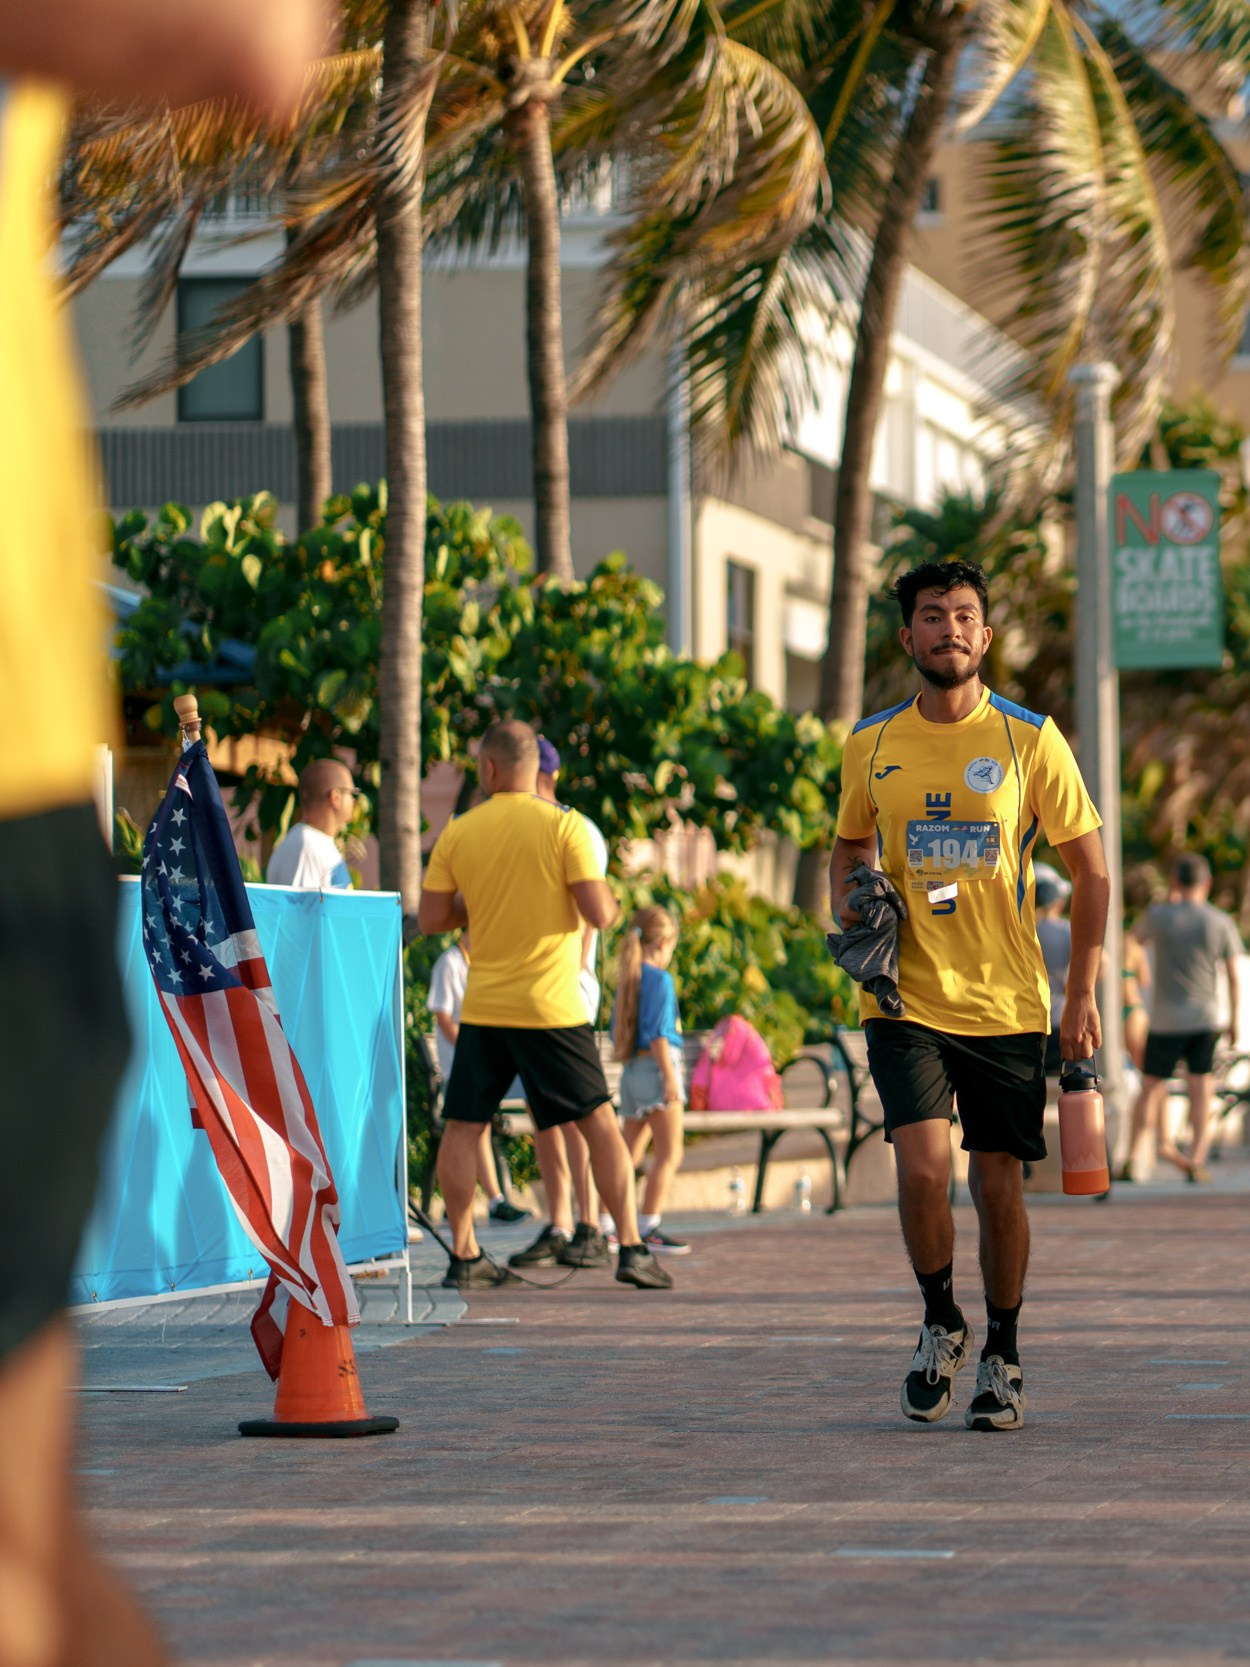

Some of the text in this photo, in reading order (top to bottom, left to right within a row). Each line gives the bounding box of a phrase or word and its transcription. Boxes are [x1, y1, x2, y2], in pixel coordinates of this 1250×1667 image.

[1117, 547, 1216, 582] SKATE
[915, 824, 991, 833] RAZOM RUN
[927, 838, 980, 869] 194
